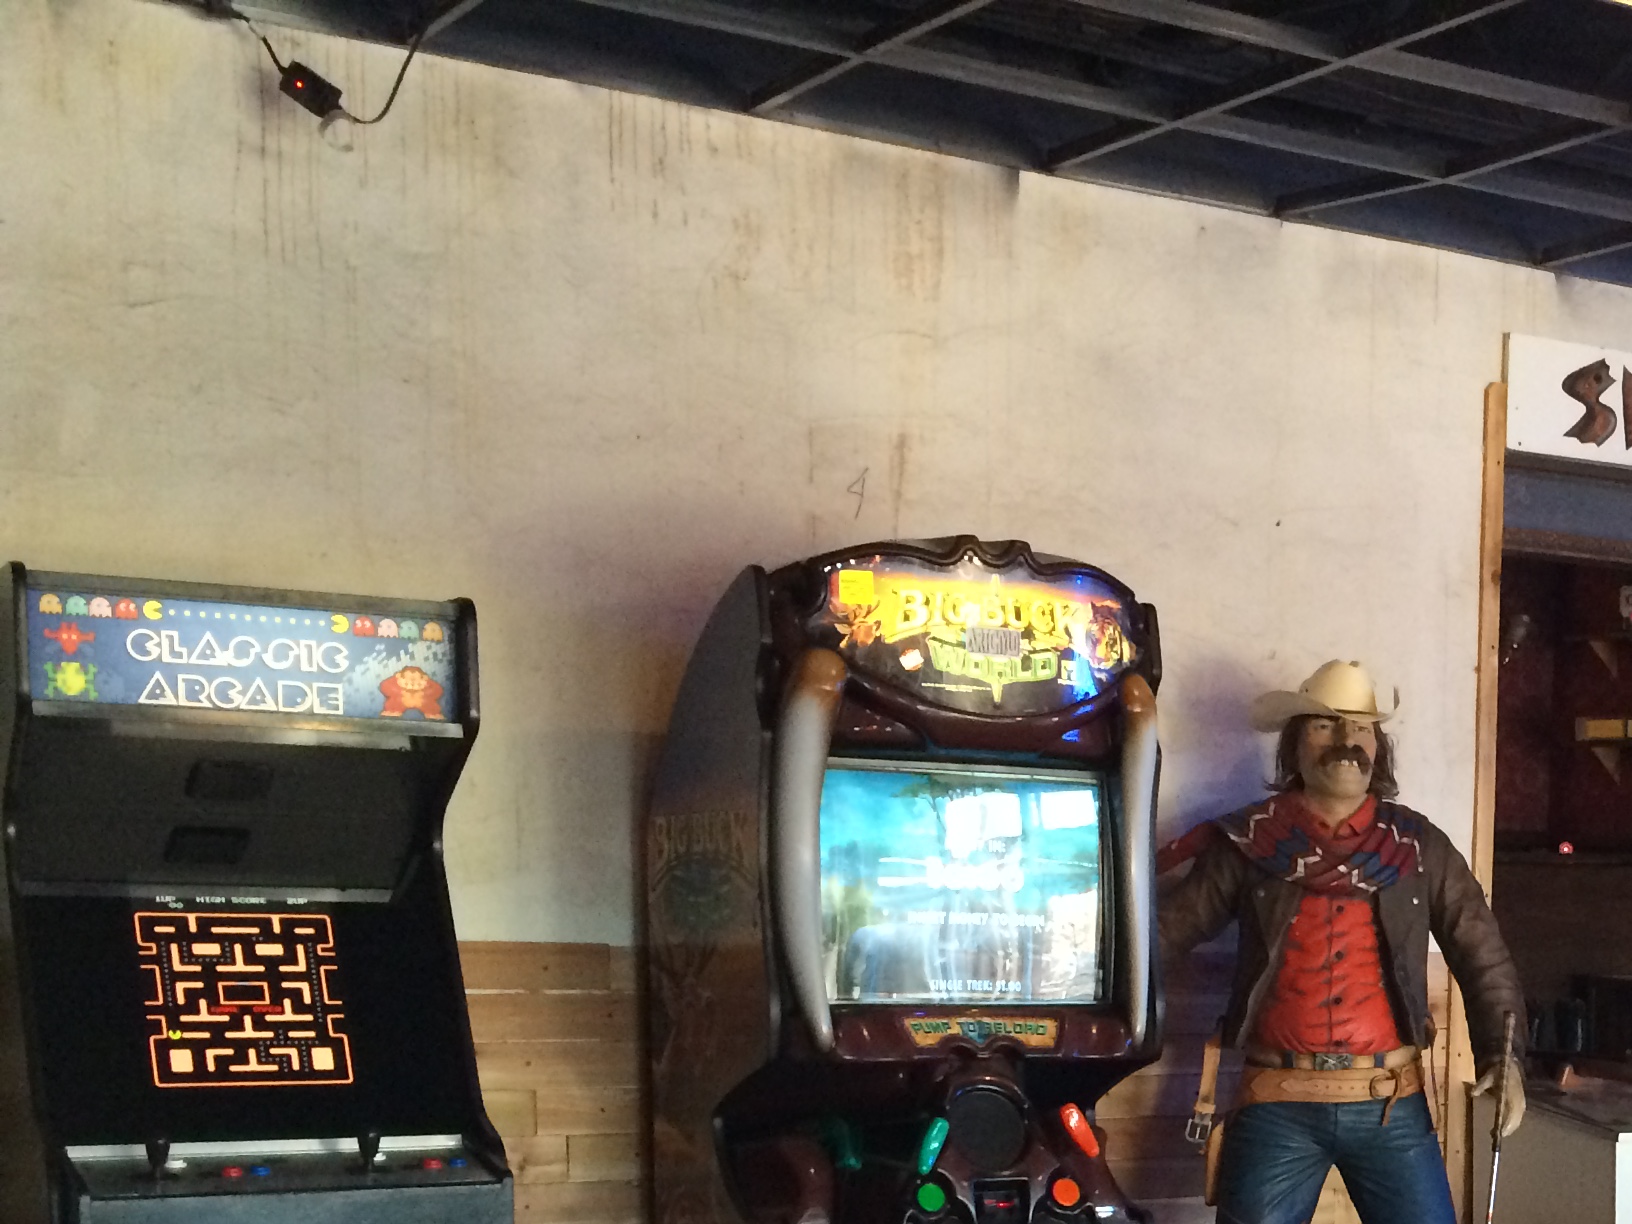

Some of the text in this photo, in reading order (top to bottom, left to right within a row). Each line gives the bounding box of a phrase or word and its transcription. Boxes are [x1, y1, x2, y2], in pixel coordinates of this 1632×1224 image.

[896, 589, 1093, 641] BIG BUCK
[126, 628, 349, 674] CLASSIC
[930, 642, 1058, 681] WORLD
[138, 671, 344, 715] ARCADE
[910, 1020, 951, 1035] PUMP
